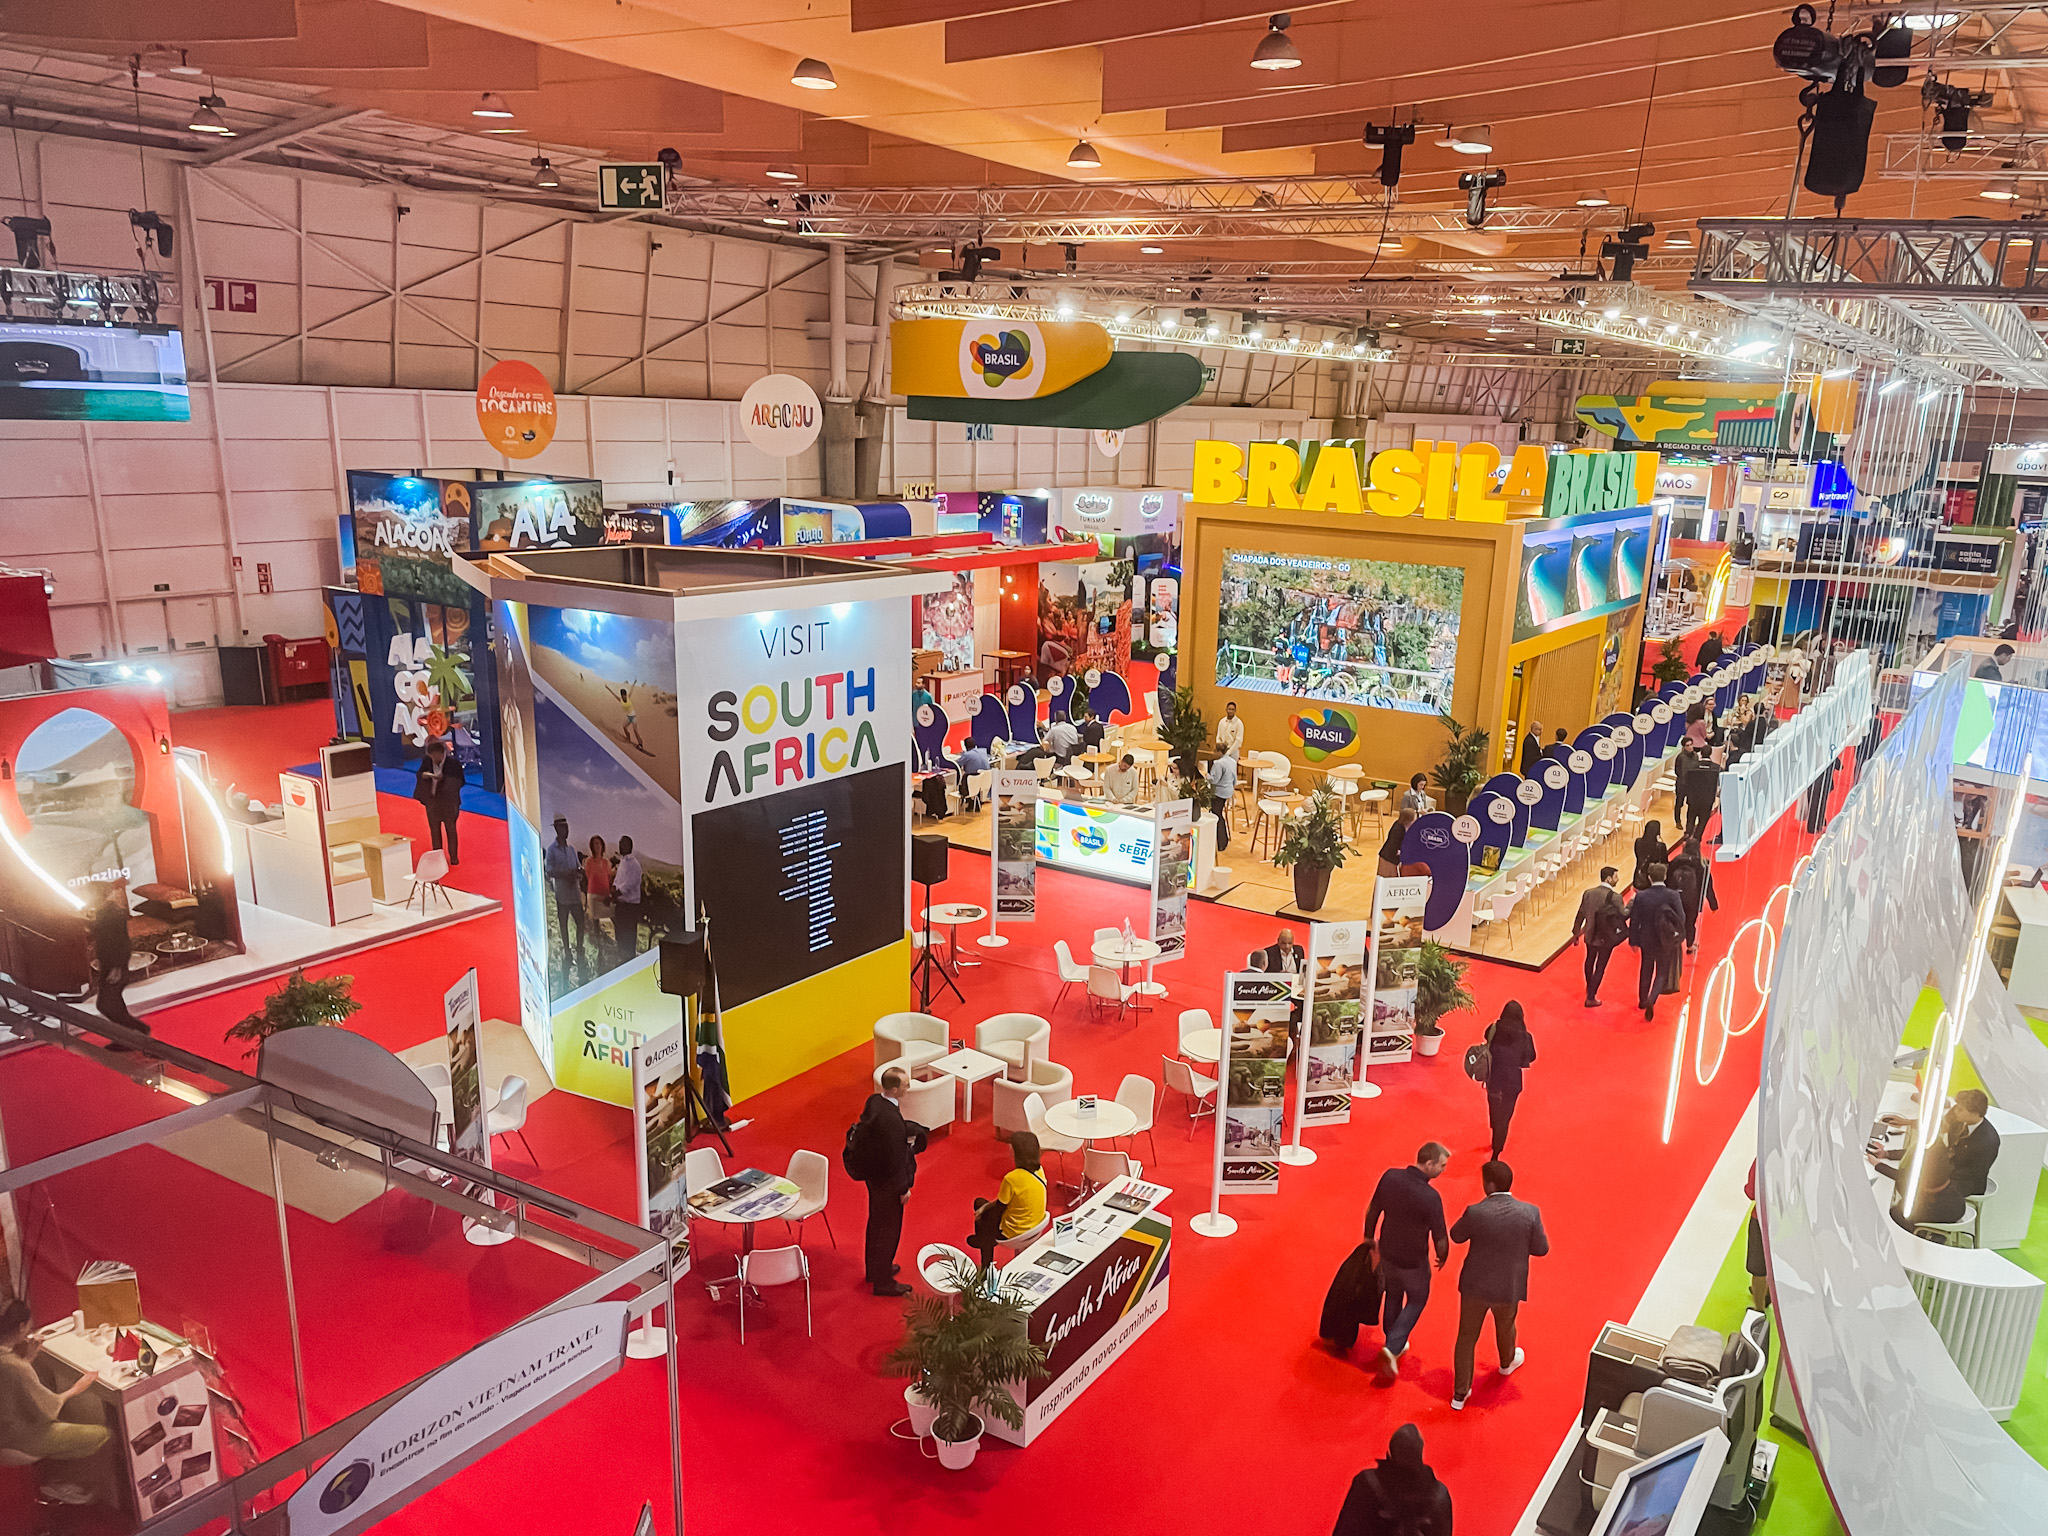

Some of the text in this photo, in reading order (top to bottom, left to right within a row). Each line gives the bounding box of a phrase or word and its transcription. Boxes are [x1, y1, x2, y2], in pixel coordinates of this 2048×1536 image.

[983, 353, 1021, 368] BRASIL
[489, 386, 525, 400] Descubra
[480, 398, 553, 415] TOCANTINS
[751, 402, 814, 429] ARACAJU
[1194, 439, 1507, 523] BRASIL
[1549, 452, 1638, 518] BRASIL
[903, 482, 935, 500] RECIFE
[510, 496, 577, 548] ALA
[375, 519, 453, 559] ALAGOAS
[1232, 553, 1269, 566] CHAPADA
[1269, 556, 1287, 567] DOS
[1287, 558, 1332, 571] VEADEIROS
[1338, 563, 1351, 572] GO
[1959, 556, 1992, 565] catarina
[760, 621, 830, 659] VISIT
[388, 633, 437, 671] ALA
[707, 667, 875, 742] SOUTH
[1305, 727, 1346, 744] BRASIL
[705, 720, 880, 803] AFRICA
[1525, 785, 1534, 793] 02
[1497, 803, 1505, 811] 01
[1461, 821, 1470, 829] 01
[1080, 835, 1102, 848] BRASIL
[1118, 843, 1155, 859] SEBRA
[67, 865, 132, 888] amazing
[1386, 888, 1422, 897] AFRICA
[1238, 985, 1278, 995] South Africa
[603, 1004, 635, 1022] VISIT
[1373, 1037, 1403, 1048] South Africa
[583, 1040, 629, 1068] AFRI
[650, 1040, 679, 1064] Across
[1307, 1096, 1340, 1108] South Africa
[1227, 1163, 1266, 1175] South Africa
[1045, 1255, 1141, 1359] South Africa
[1040, 1299, 1159, 1421] Inspirando novos caminhos
[381, 1324, 603, 1463] HORIZON VIETNAM TRAVEL
[440, 1429, 453, 1441] fim
[454, 1422, 465, 1432] do
[467, 1404, 495, 1424] mundo
[501, 1381, 532, 1403] Viagens
[533, 1372, 547, 1384] dos
[568, 1344, 593, 1363] sonhos
